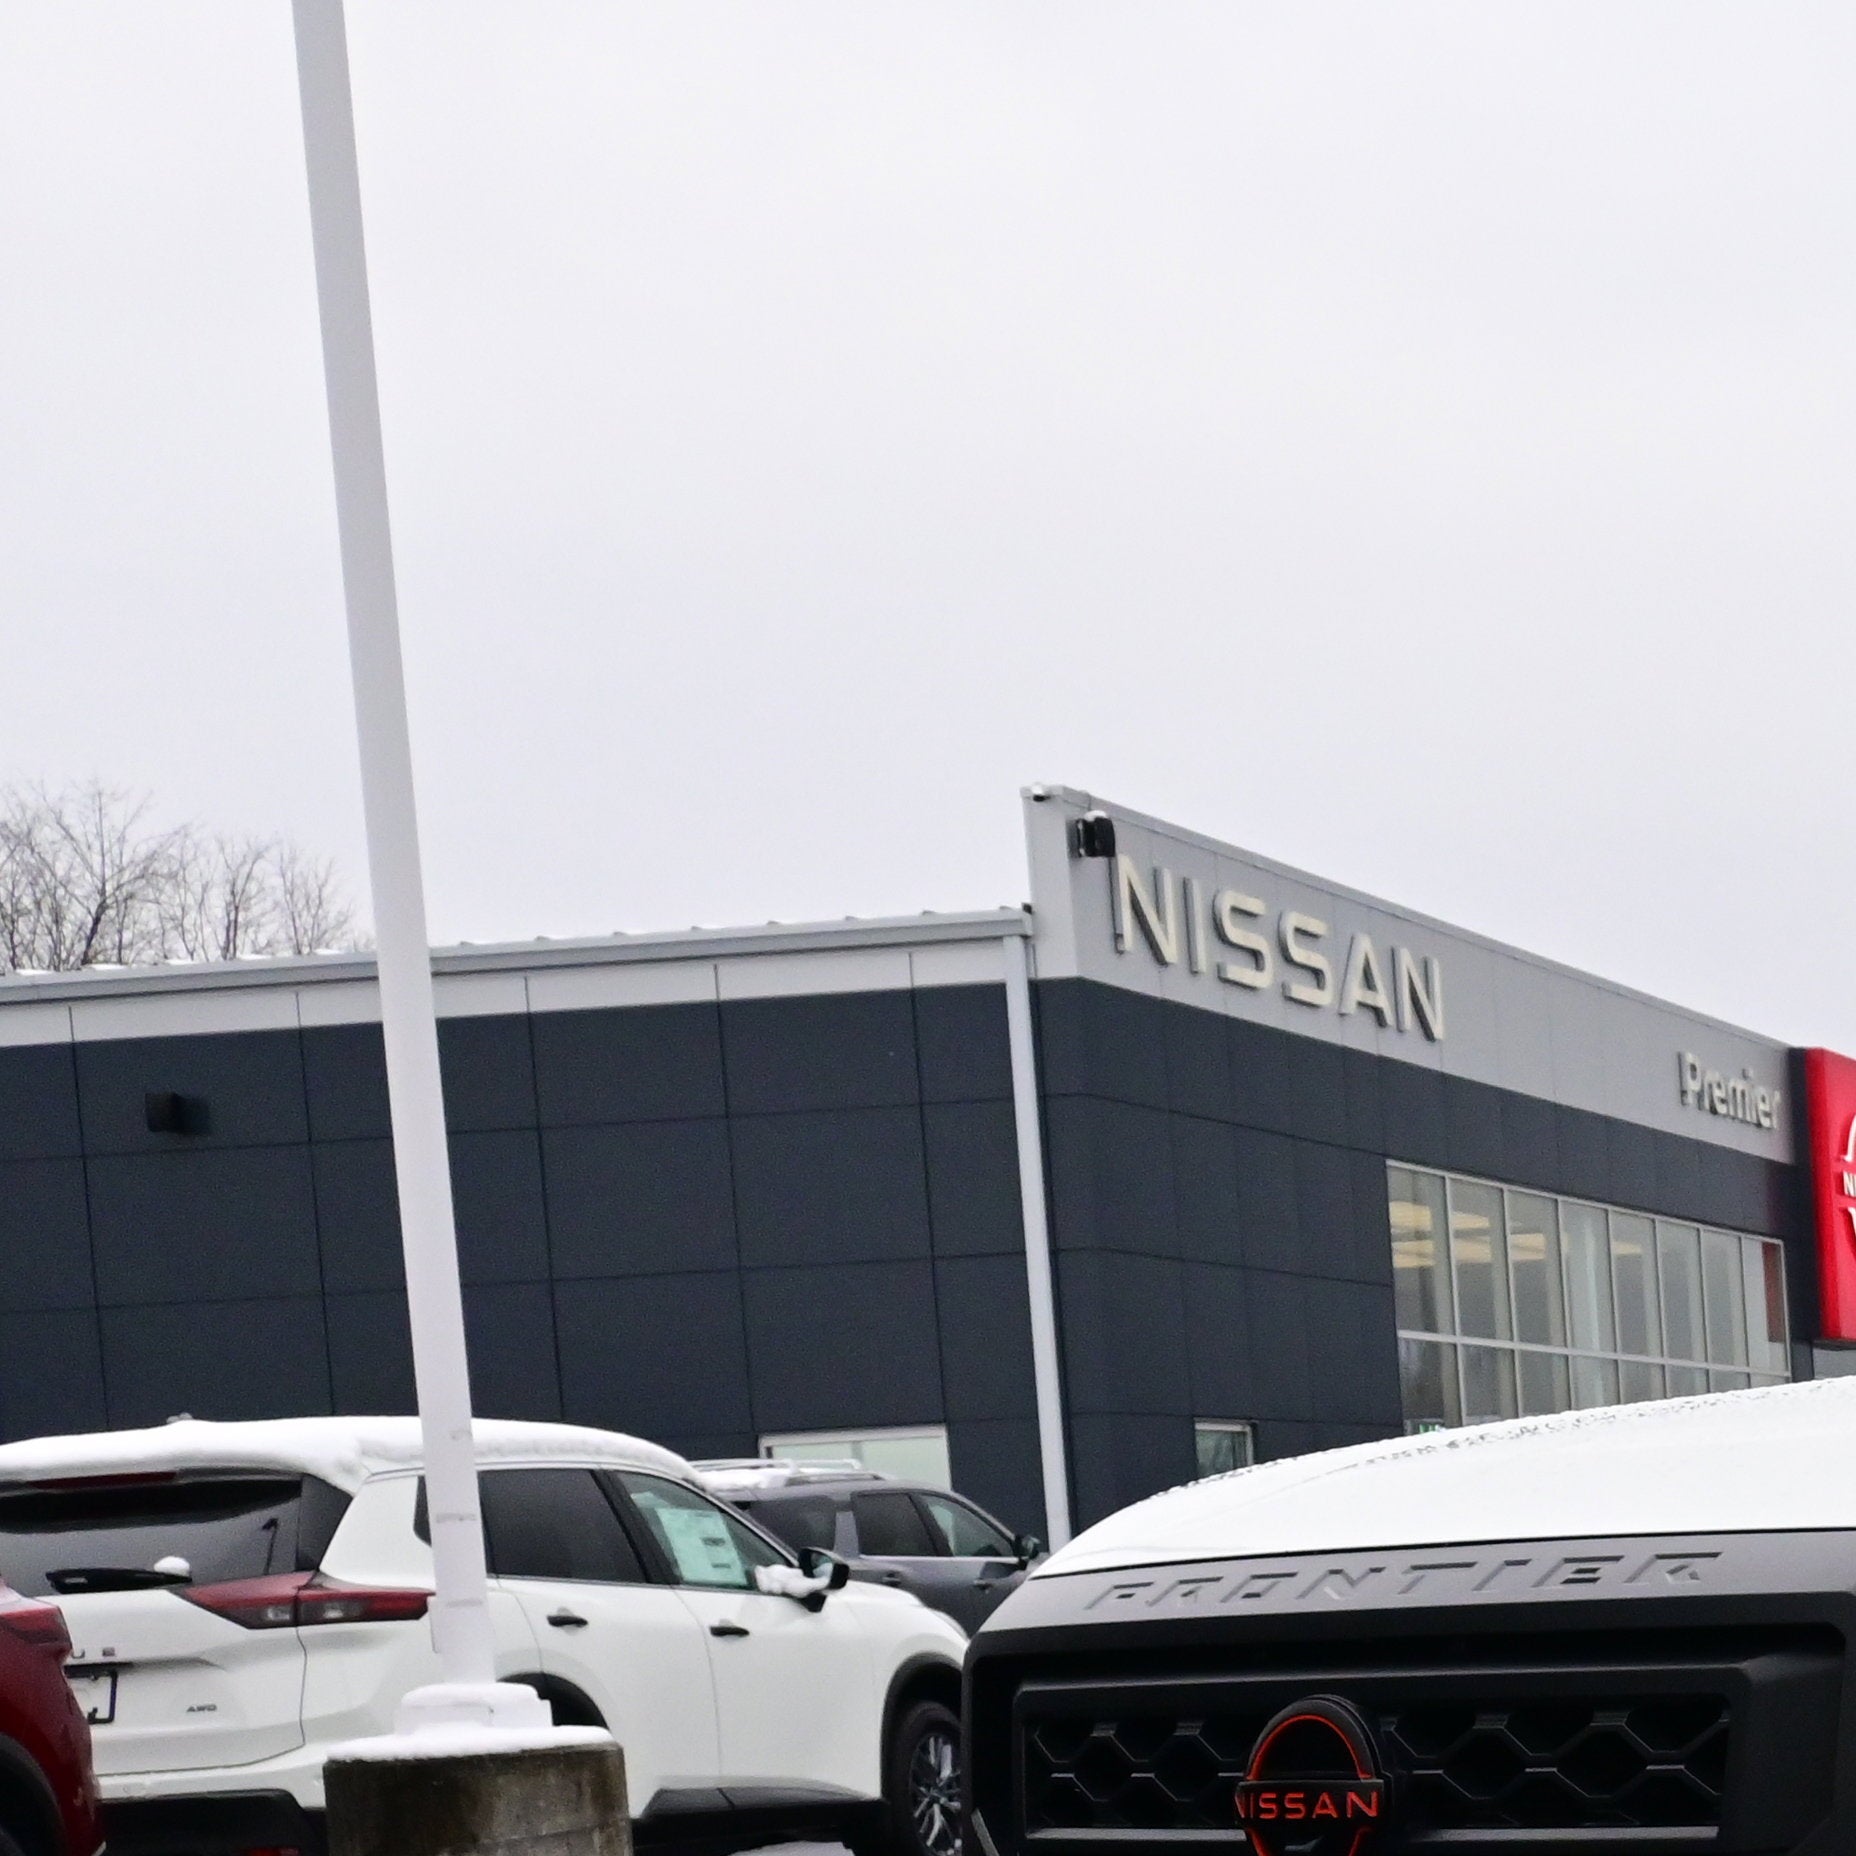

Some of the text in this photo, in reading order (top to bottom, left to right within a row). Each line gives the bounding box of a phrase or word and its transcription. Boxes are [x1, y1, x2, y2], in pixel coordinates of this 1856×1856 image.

[1110, 853, 1444, 1042] NISSAN
[1679, 1052, 1780, 1130] Premier
[1084, 1551, 1722, 1610] FRONTIER
[186, 1703, 218, 1713] AWD
